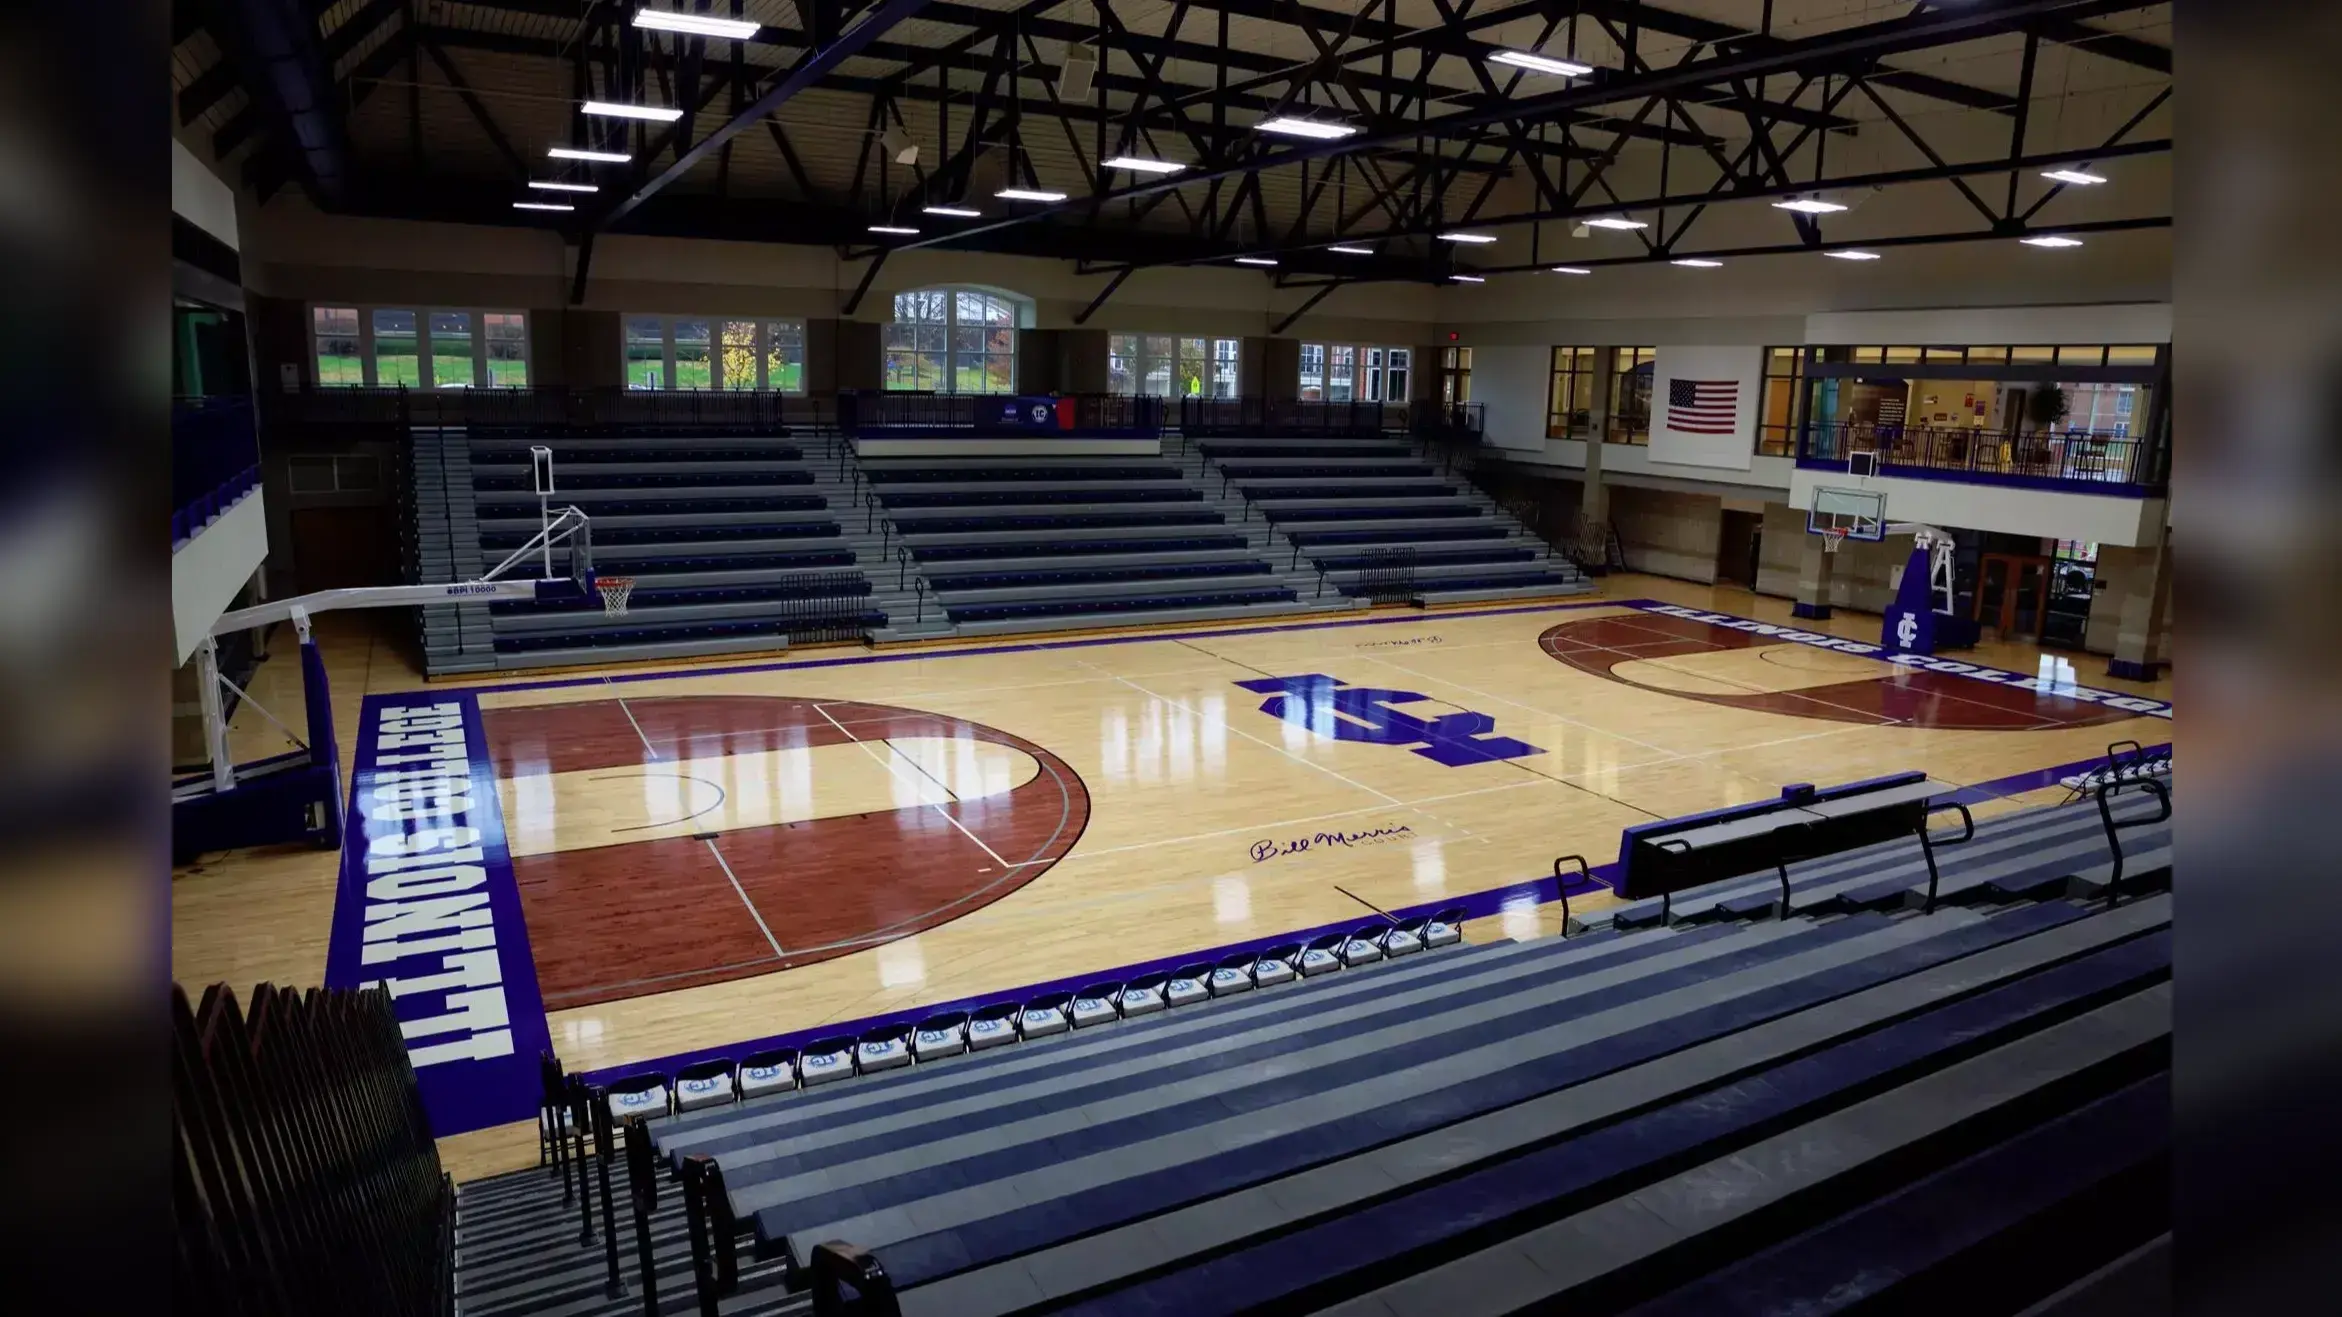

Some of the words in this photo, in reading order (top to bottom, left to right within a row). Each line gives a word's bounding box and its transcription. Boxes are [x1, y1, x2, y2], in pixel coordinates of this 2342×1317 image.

[470, 585, 497, 593] 10000
[1643, 605, 1883, 653] ILLINOIS
[372, 702, 476, 821] COLLEGE
[1250, 839, 1313, 863] Bill
[1314, 822, 1411, 848] Merris
[359, 826, 515, 1068] ILLINOIS
